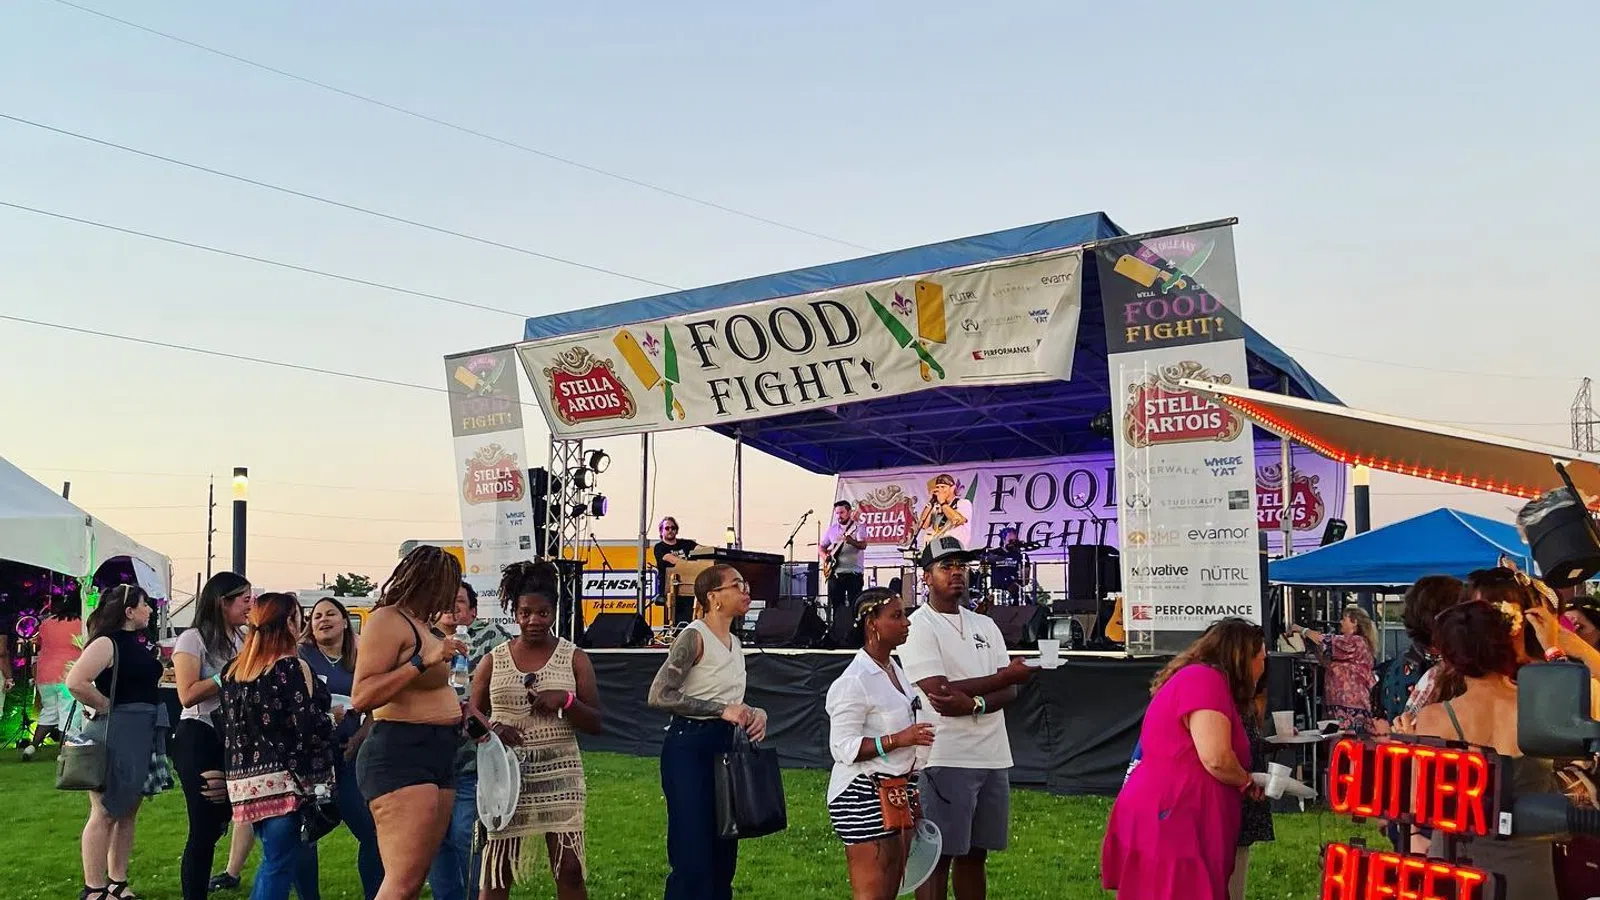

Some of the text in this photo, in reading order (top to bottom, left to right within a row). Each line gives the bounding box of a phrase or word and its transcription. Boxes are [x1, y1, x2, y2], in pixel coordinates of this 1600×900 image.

[1124, 292, 1223, 325] FOOD
[685, 299, 862, 372] FOOD
[1126, 317, 1225, 344] FIGHT!
[559, 377, 614, 398] STELLA
[707, 356, 883, 417] FIGHT!
[568, 394, 621, 414] ARTOIS
[1145, 395, 1221, 415] STELLA
[1146, 412, 1222, 434] ARTOIS
[1204, 456, 1243, 467] WHERE
[474, 466, 513, 482] STELLA
[475, 480, 515, 496] ARTOIS
[858, 510, 905, 525] STELLA
[1257, 507, 1306, 522] RTOIS
[865, 523, 905, 538] RTOIS
[1188, 527, 1250, 541] evamor
[1155, 605, 1253, 616] PERFORMANCE
[1329, 739, 1488, 837] GLITTER
